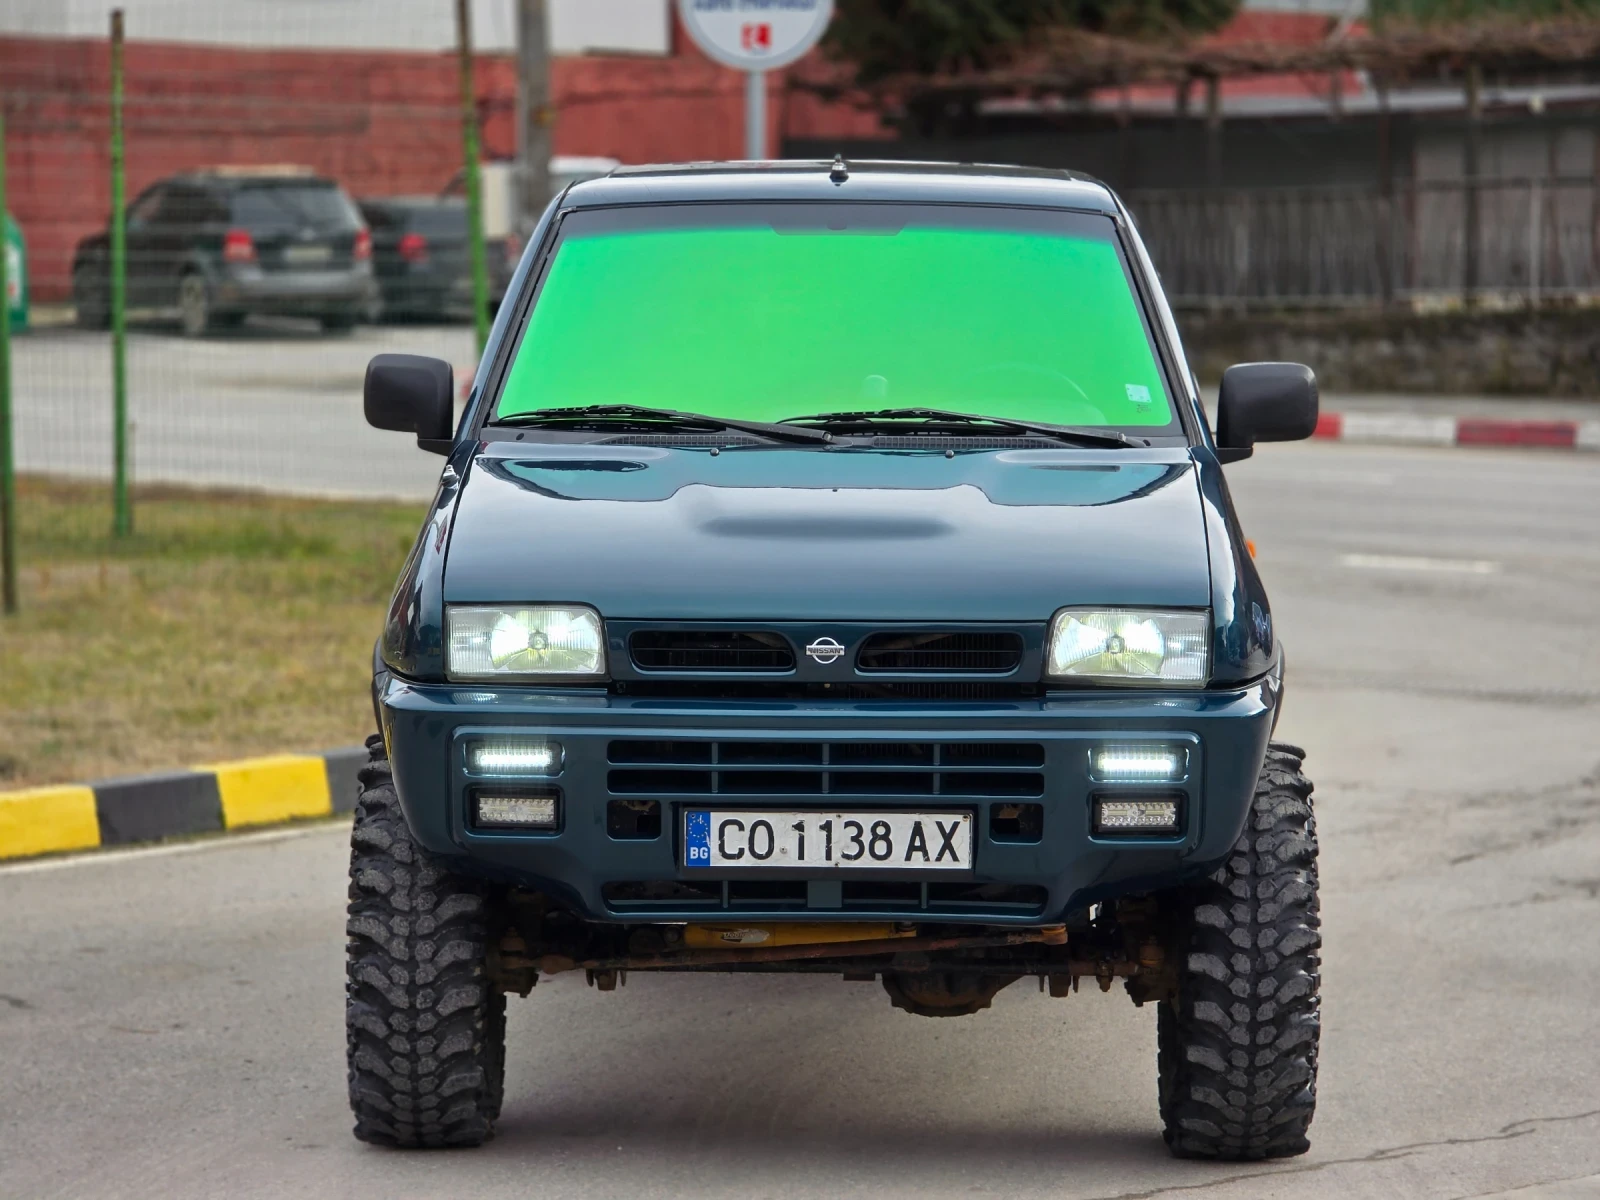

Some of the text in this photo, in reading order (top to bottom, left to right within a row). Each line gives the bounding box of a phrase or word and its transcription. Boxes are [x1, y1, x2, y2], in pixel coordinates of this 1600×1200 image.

[690, 847, 709, 859] BG
[791, 820, 893, 861] 1138
[904, 821, 961, 862] AX
